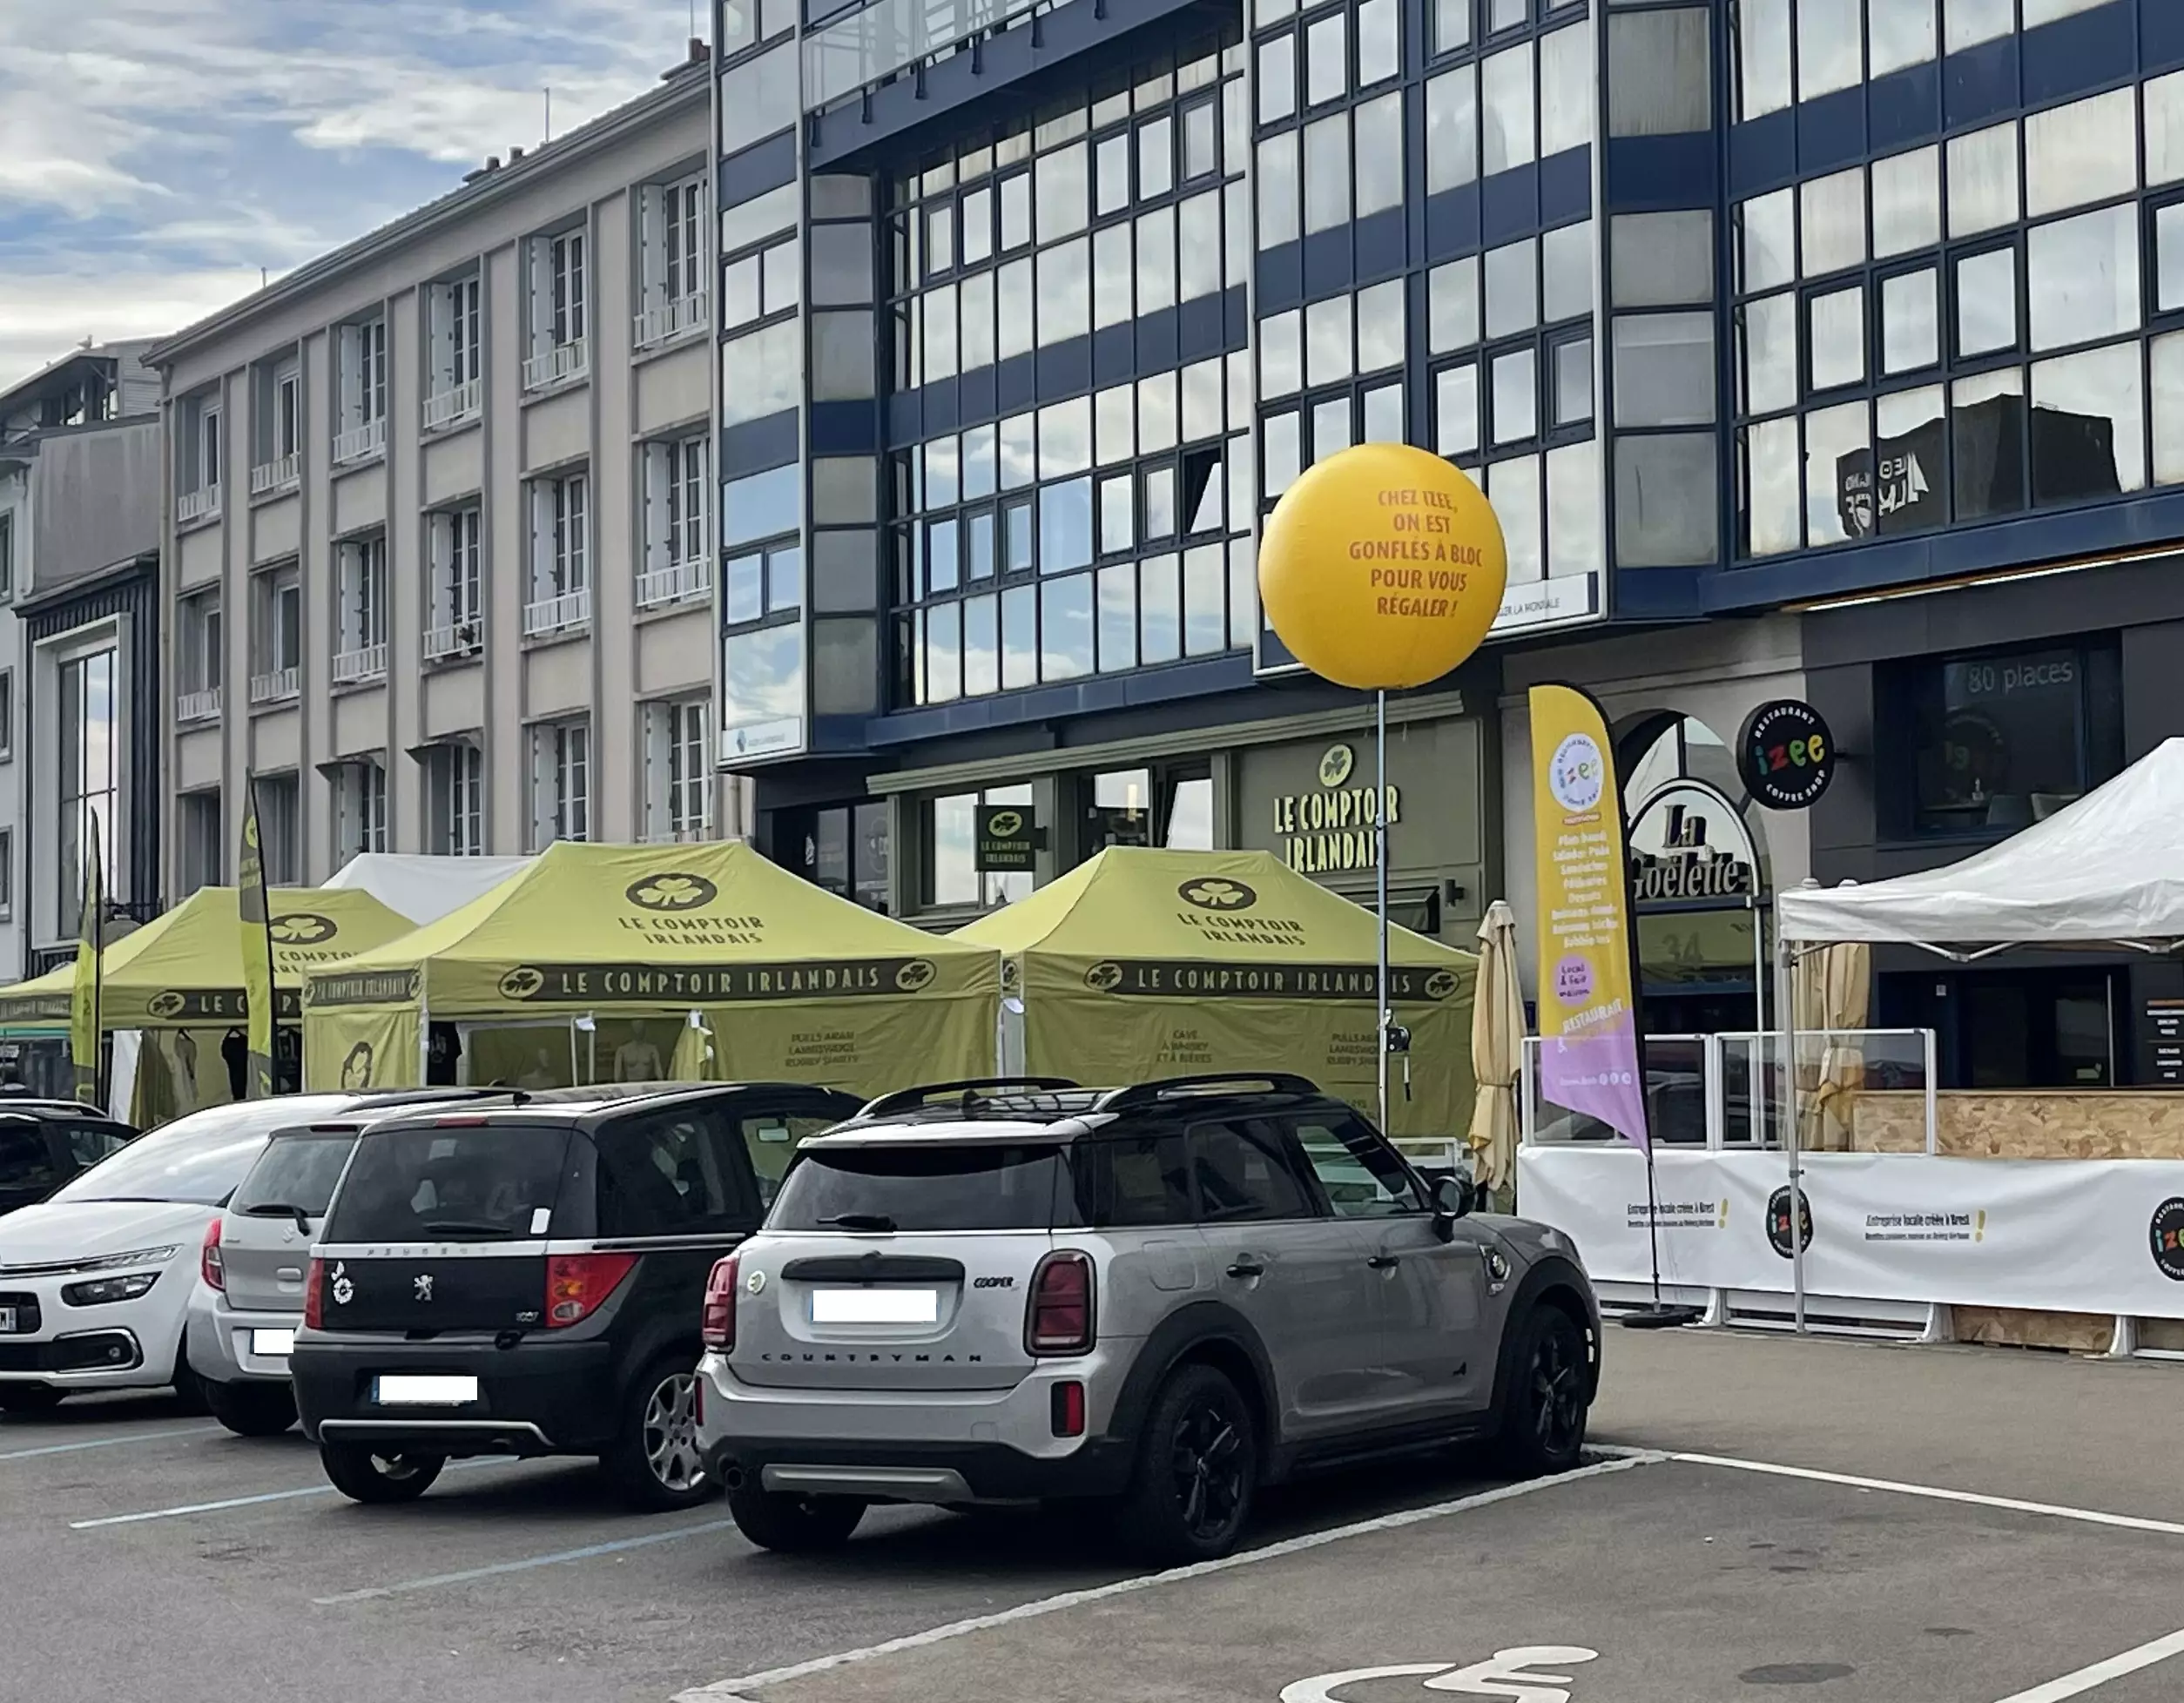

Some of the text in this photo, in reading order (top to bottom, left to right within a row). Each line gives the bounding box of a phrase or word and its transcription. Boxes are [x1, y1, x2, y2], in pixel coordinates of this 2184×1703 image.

[1378, 489, 1419, 507] CHEZ
[1393, 514, 1451, 534] ON EST
[1349, 535, 1483, 567] GONFLÉS À BLOC
[1371, 569, 1467, 592] POUR VOUS
[1377, 591, 1459, 618] RÉGALER !
[1967, 661, 2073, 695] 80 places
[1755, 706, 1815, 738] RESTAURANT
[1755, 734, 1825, 776] izee
[1765, 770, 1826, 802] COFFEE SHOP
[1274, 785, 1399, 833] LE COMPTOR
[1662, 804, 1707, 848] La
[1285, 830, 1380, 872] IRLANDAI
[617, 916, 765, 931] LE COMPTOIR
[1177, 912, 1305, 932] LE COMPTOIR
[644, 932, 764, 946] IRLANDAIS
[1201, 929, 1306, 946] IRLANDAIS
[279, 950, 358, 961] COMPTO
[561, 966, 880, 994] LE COMPTOIR IRLANDAIS
[1137, 968, 1411, 994] LE COMPTOIR IRLANDIS
[200, 995, 223, 1013] LE
[1770, 1210, 1809, 1232] ize
[2155, 1202, 2184, 1224] RESTAUR
[974, 1276, 1014, 1289] COOPER
[760, 1352, 982, 1363] COUNTRYMAN
